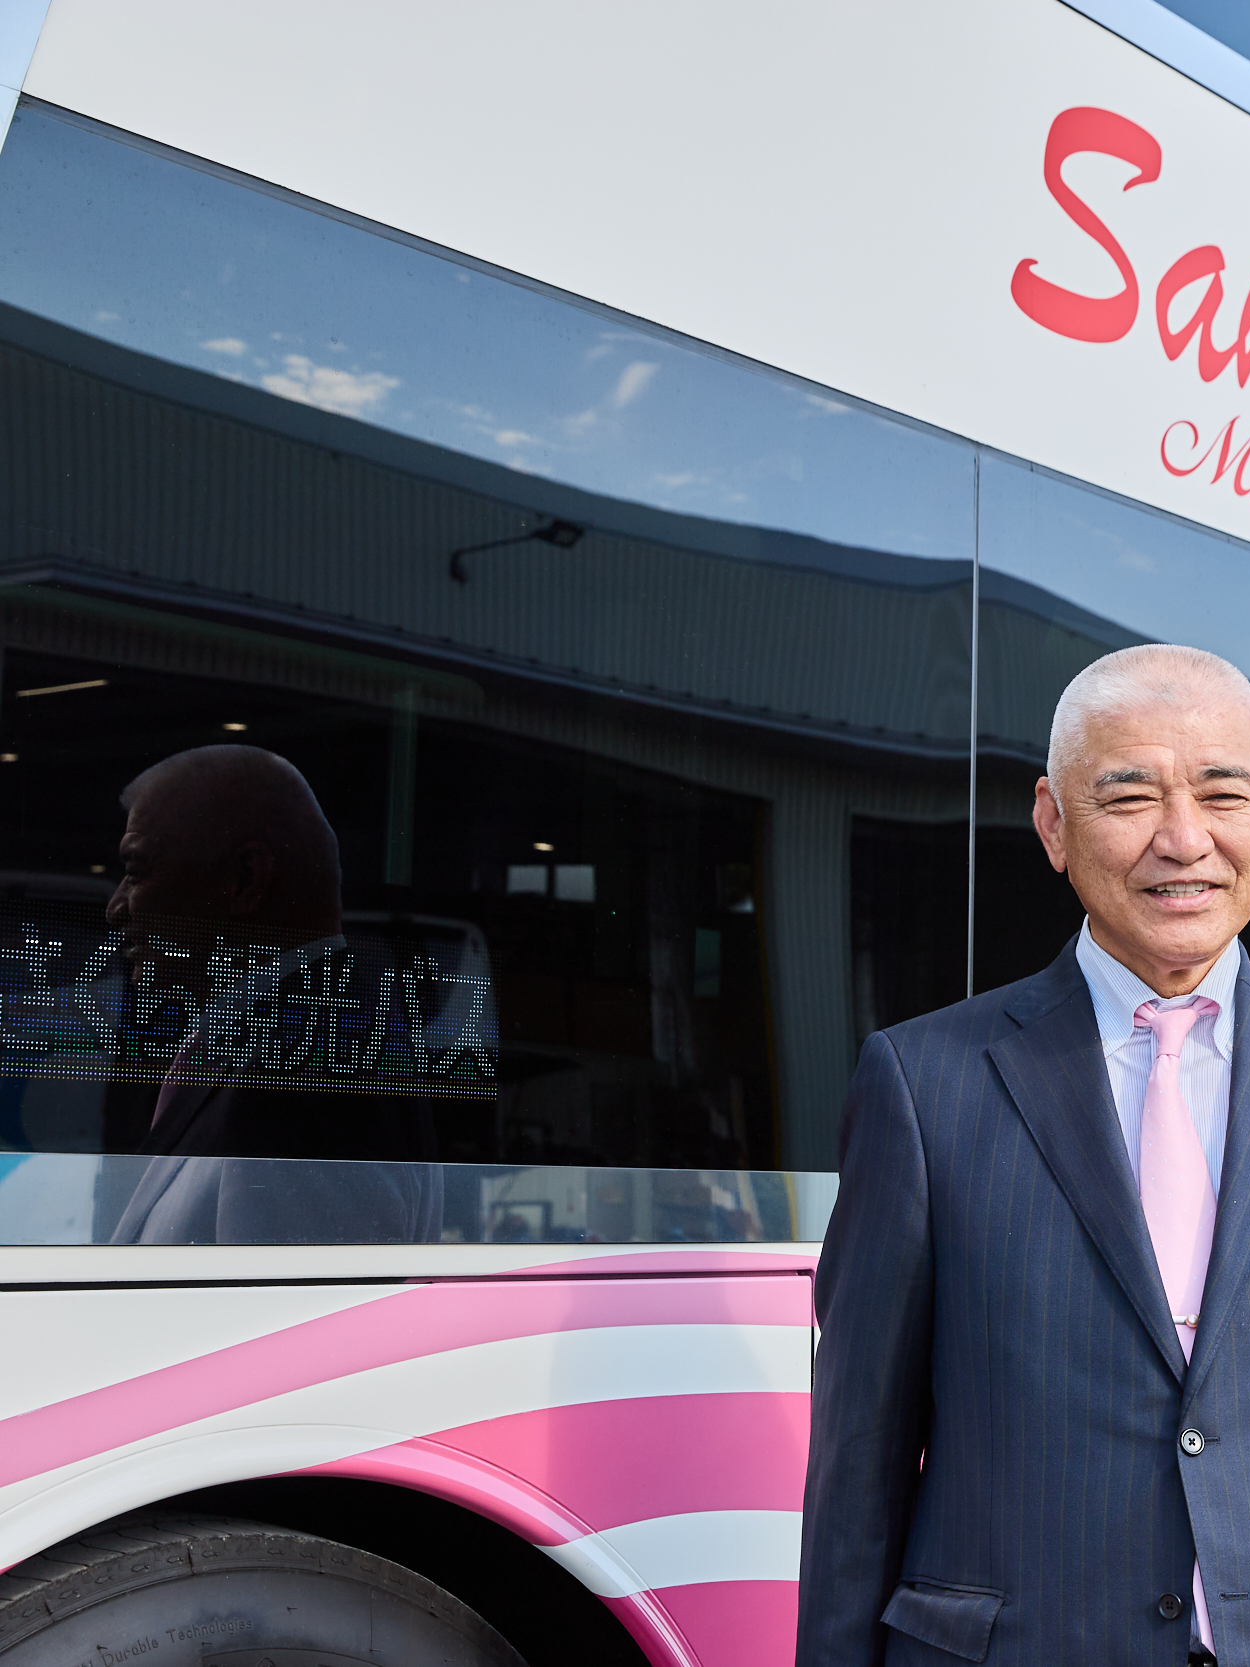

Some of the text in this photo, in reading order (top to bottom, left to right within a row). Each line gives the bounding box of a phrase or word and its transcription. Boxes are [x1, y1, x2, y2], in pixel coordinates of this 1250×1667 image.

[0, 921, 496, 1078] さくら観光バス
[101, 1617, 253, 1667] Durable Technologies
